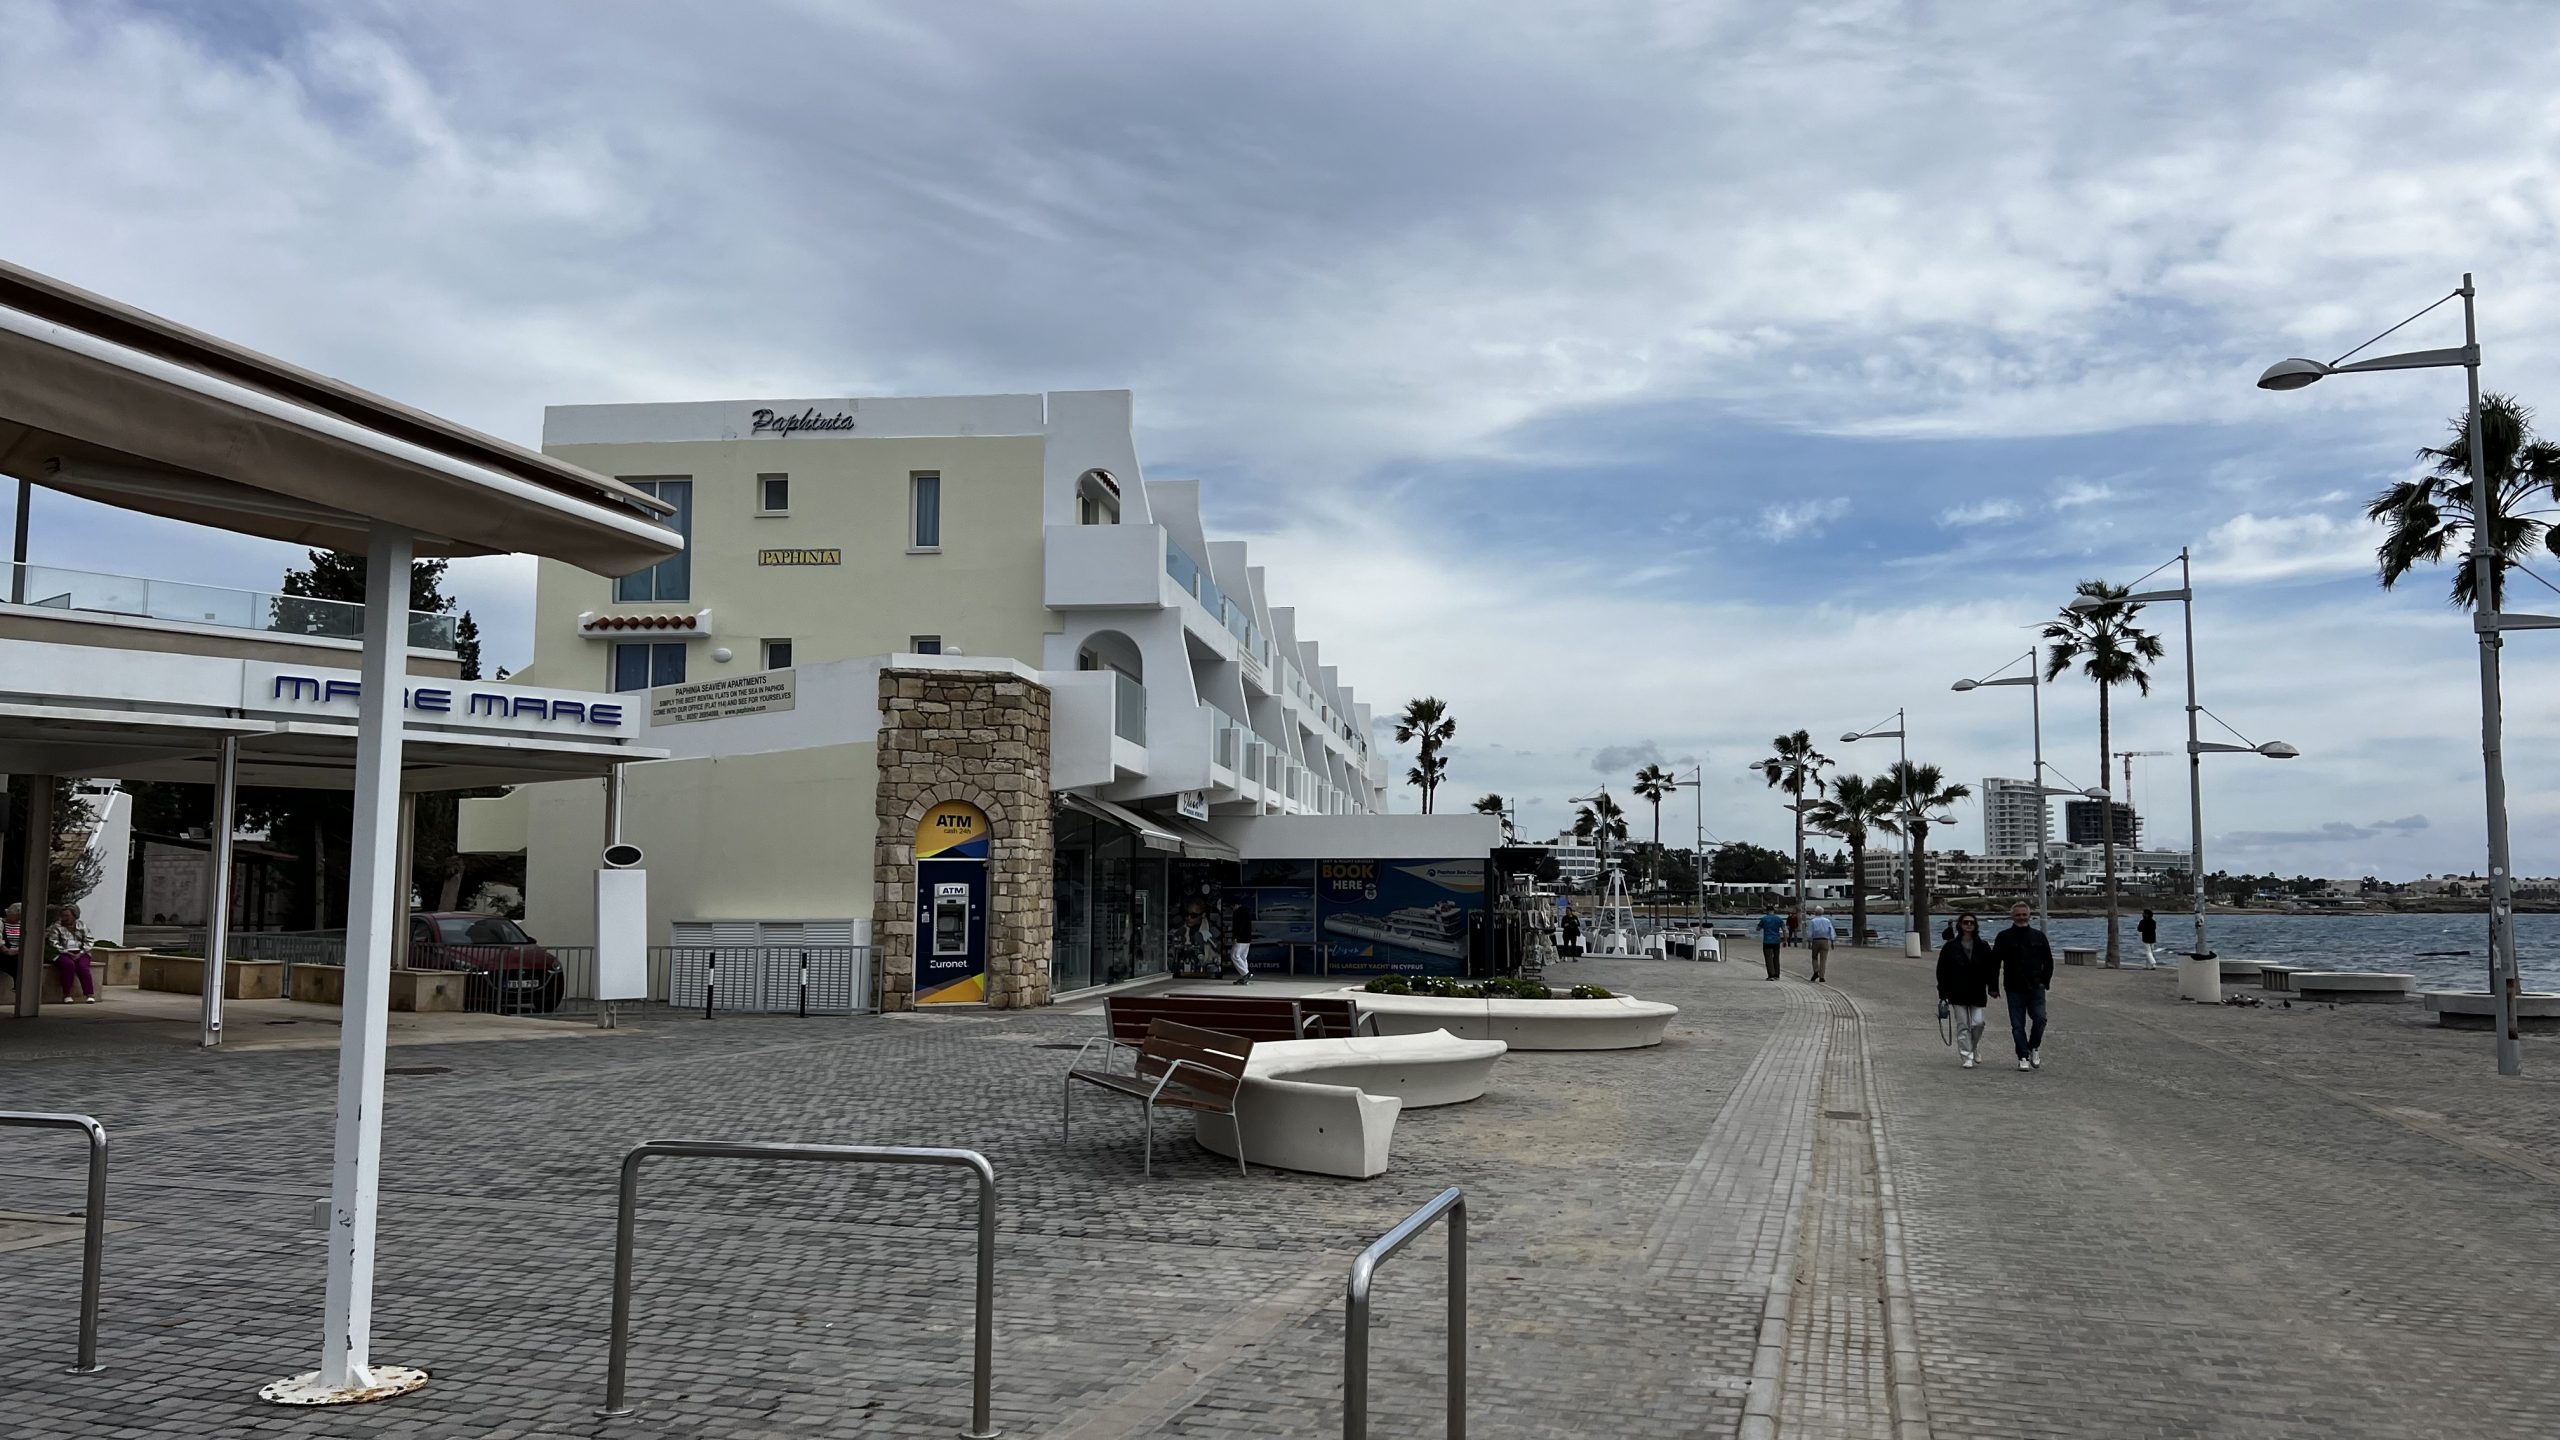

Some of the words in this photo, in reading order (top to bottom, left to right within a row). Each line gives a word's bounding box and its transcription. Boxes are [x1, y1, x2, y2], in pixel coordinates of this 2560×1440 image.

[752, 407, 855, 438] Paphinia
[763, 551, 836, 564] PAPHINIA
[675, 686, 701, 696] PAPHINIA
[702, 681, 727, 692] SEAVIEW
[727, 676, 767, 688] APARTMENTS
[714, 691, 730, 700] FLATS
[748, 687, 758, 695] SEA
[765, 684, 785, 692] PAPHOS
[275, 675, 451, 712] MAE
[470, 692, 623, 726] MARE
[677, 705, 687, 713] OUR
[688, 703, 703, 712] OFFICE
[738, 697, 747, 705] SEE
[748, 696, 758, 704] FOR
[759, 692, 792, 702] YOURSELVES
[936, 814, 972, 828] ATM
[959, 827, 971, 835] 24h
[1322, 864, 1375, 879] BOOK
[1332, 879, 1363, 890] HERE
[929, 960, 968, 969] Euronet
